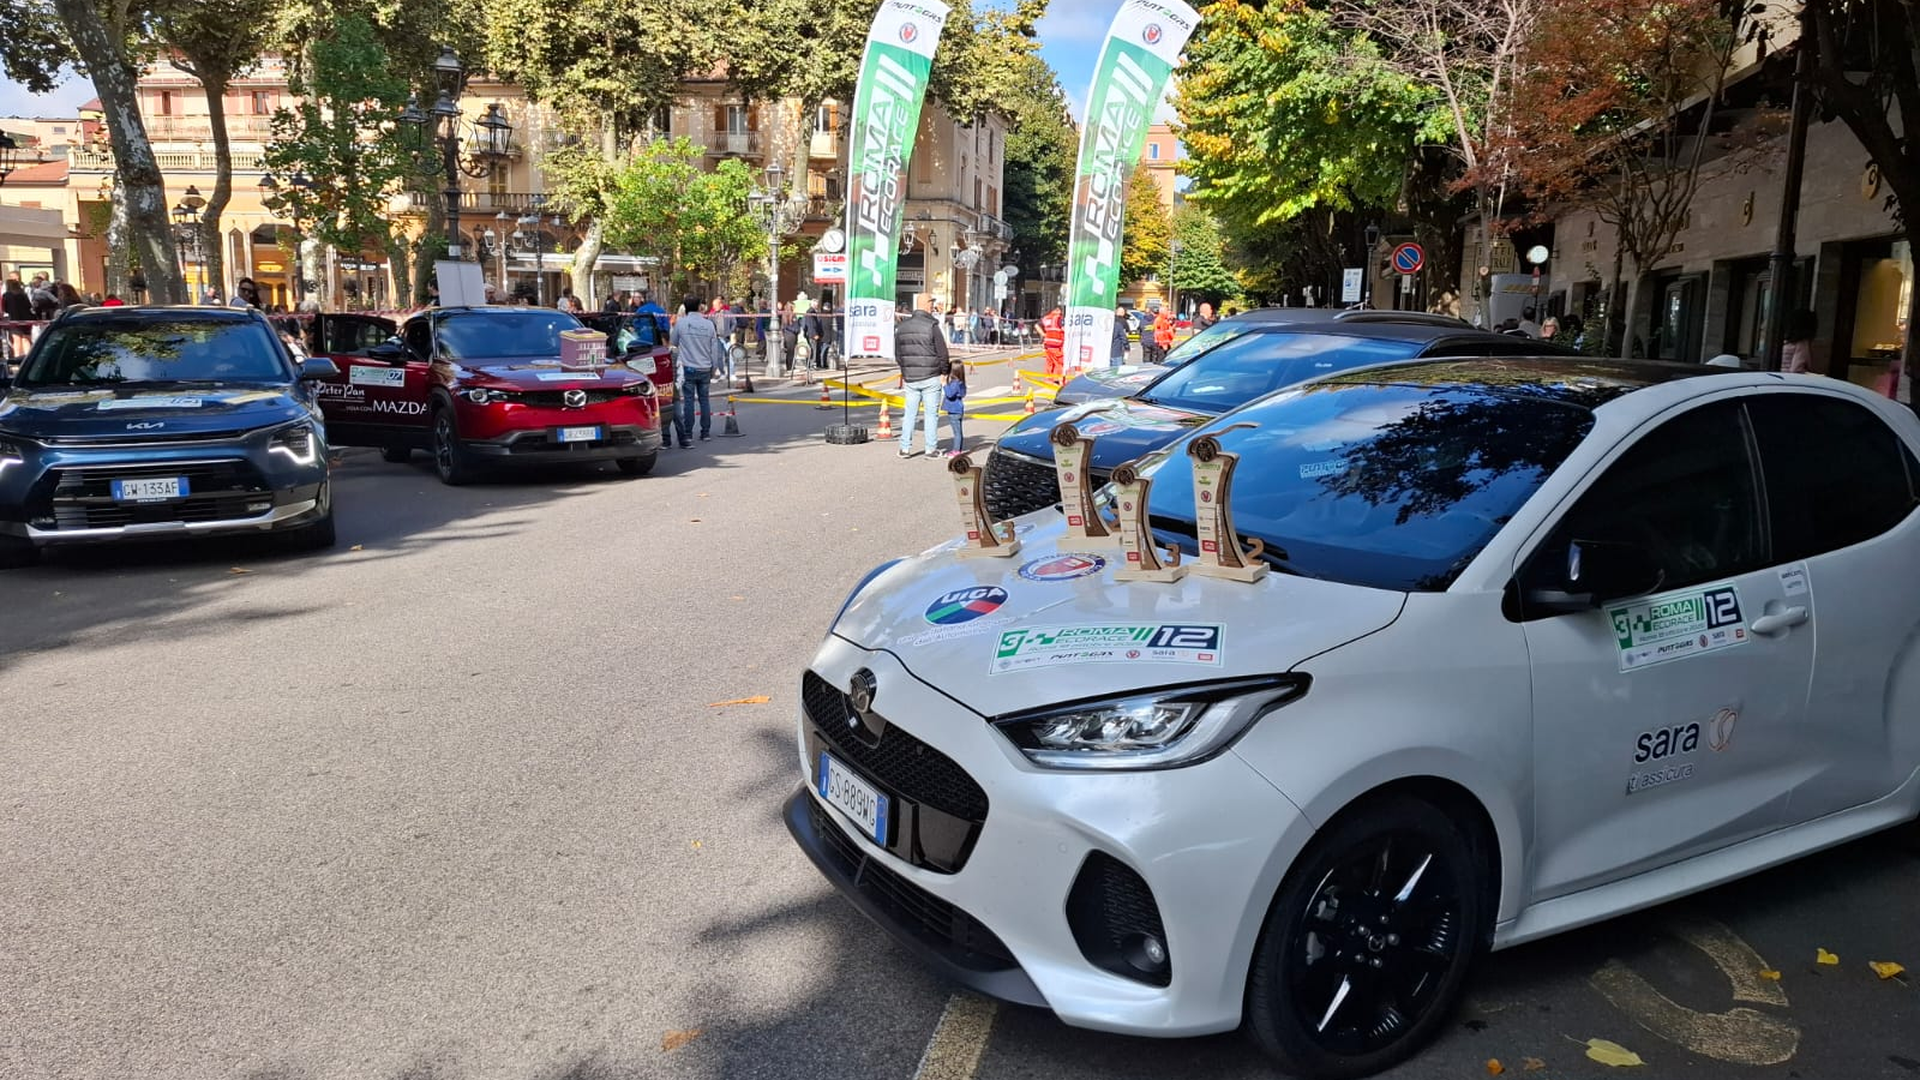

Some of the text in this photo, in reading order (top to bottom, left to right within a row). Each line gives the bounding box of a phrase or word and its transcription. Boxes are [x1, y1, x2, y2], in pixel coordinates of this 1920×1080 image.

[860, 100, 892, 224] ROMA
[880, 104, 908, 232] ECORACE
[1085, 101, 1125, 230] ROMA
[849, 304, 877, 317] sara
[373, 400, 427, 415] MAZDA
[1001, 521, 1015, 543] 3
[1164, 543, 1181, 567] 3
[1247, 537, 1265, 566] 2
[1613, 591, 1738, 640] 3 ROMA 12
[1652, 614, 1695, 631] ECORACE
[1000, 627, 1215, 651] 3 ROMA 12
[1055, 635, 1129, 644] ECORACE
[1635, 722, 1700, 763] sara
[1641, 763, 1693, 788] assicura
